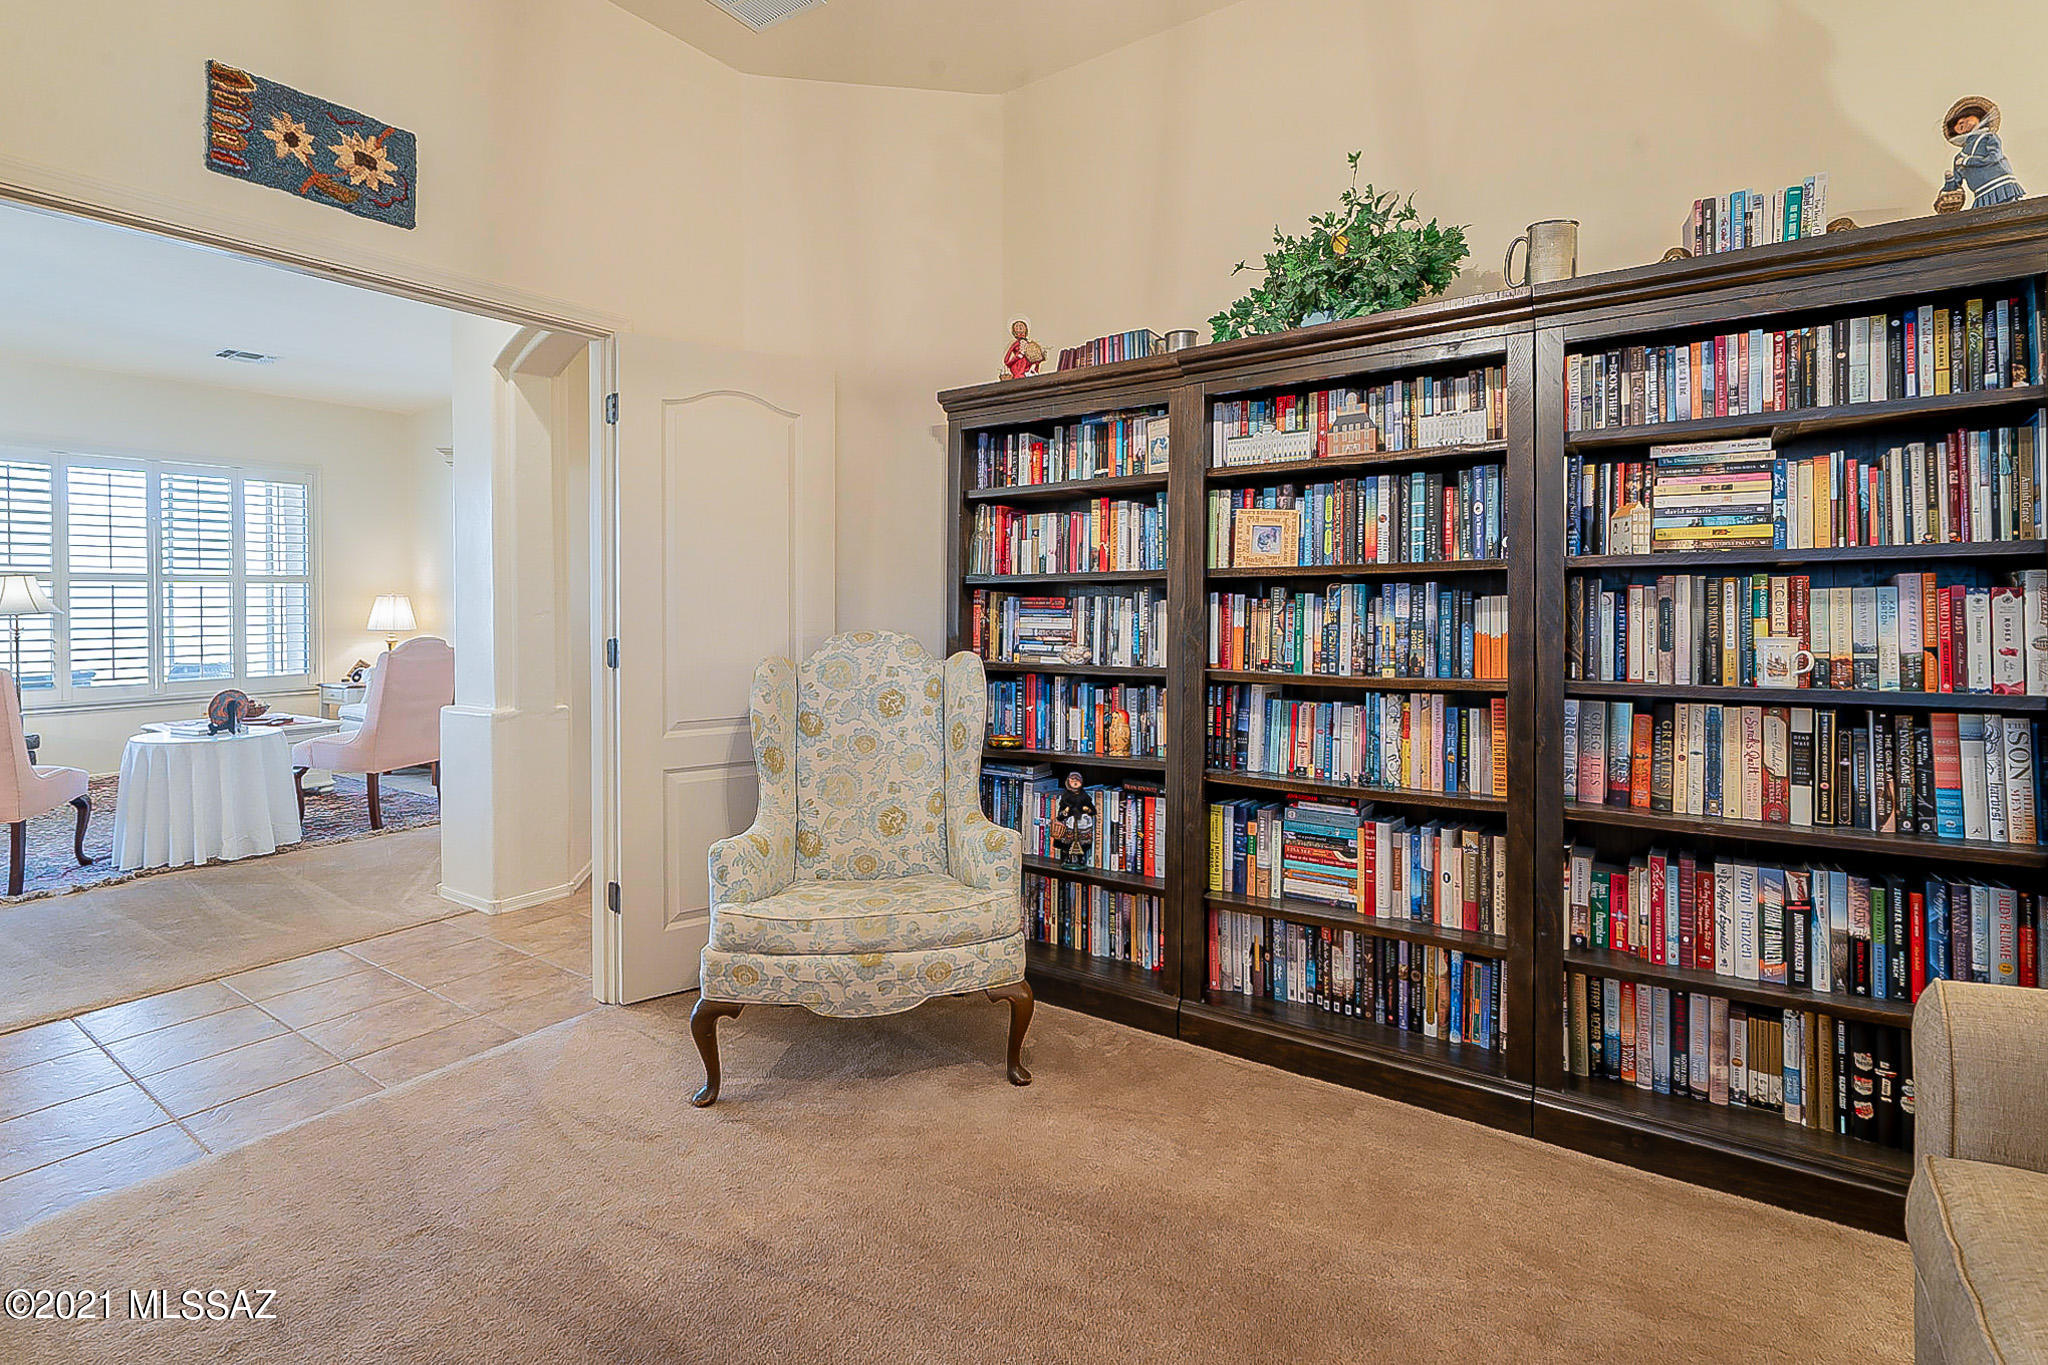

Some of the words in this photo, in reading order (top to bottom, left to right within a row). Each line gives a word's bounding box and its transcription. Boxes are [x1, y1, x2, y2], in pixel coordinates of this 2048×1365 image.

[1608, 364, 1618, 389] BOOK
[1608, 390, 1618, 417] THIEF
[2021, 476, 2031, 500] Amish
[2021, 502, 2031, 523] Grace
[1940, 591, 1949, 619] WARD
[1709, 606, 1719, 638] PRINCESS
[1940, 621, 1949, 641] JUST
[1955, 615, 1963, 635] JUST
[1564, 706, 1577, 746] GREG
[1590, 712, 1601, 750] GREG
[1662, 720, 1672, 756] GREG
[1744, 717, 1760, 749] Sarah's
[1875, 734, 1884, 761] SWANN
[1885, 734, 1893, 748] THE
[1899, 729, 1910, 756] LYING
[1617, 756, 1626, 783] ILES
[1744, 751, 1760, 775] Quilt
[1885, 750, 1893, 771] GIRLS
[2007, 731, 2032, 781] SON
[1590, 756, 1601, 786] ILES
[1662, 762, 1672, 789] ILES
[1875, 763, 1884, 790] STREET
[1885, 773, 1893, 782] AT
[1899, 757, 1910, 784] GAME
[1989, 783, 2004, 822] harvest
[2011, 789, 2022, 830] MEYER
[1737, 871, 1754, 905] Purity
[1764, 886, 1783, 928] JONATHAN
[1894, 888, 1902, 922] JENNIFER
[1999, 893, 2012, 921] JUDY
[1741, 911, 1754, 958] Franzen
[1794, 913, 1804, 942] JONATHAN
[1999, 923, 2012, 960] BLUME
[1764, 929, 1783, 965] FRANZEN
[1590, 981, 1600, 1009] JEFFREY
[1590, 1012, 1600, 1040] ARCHER
